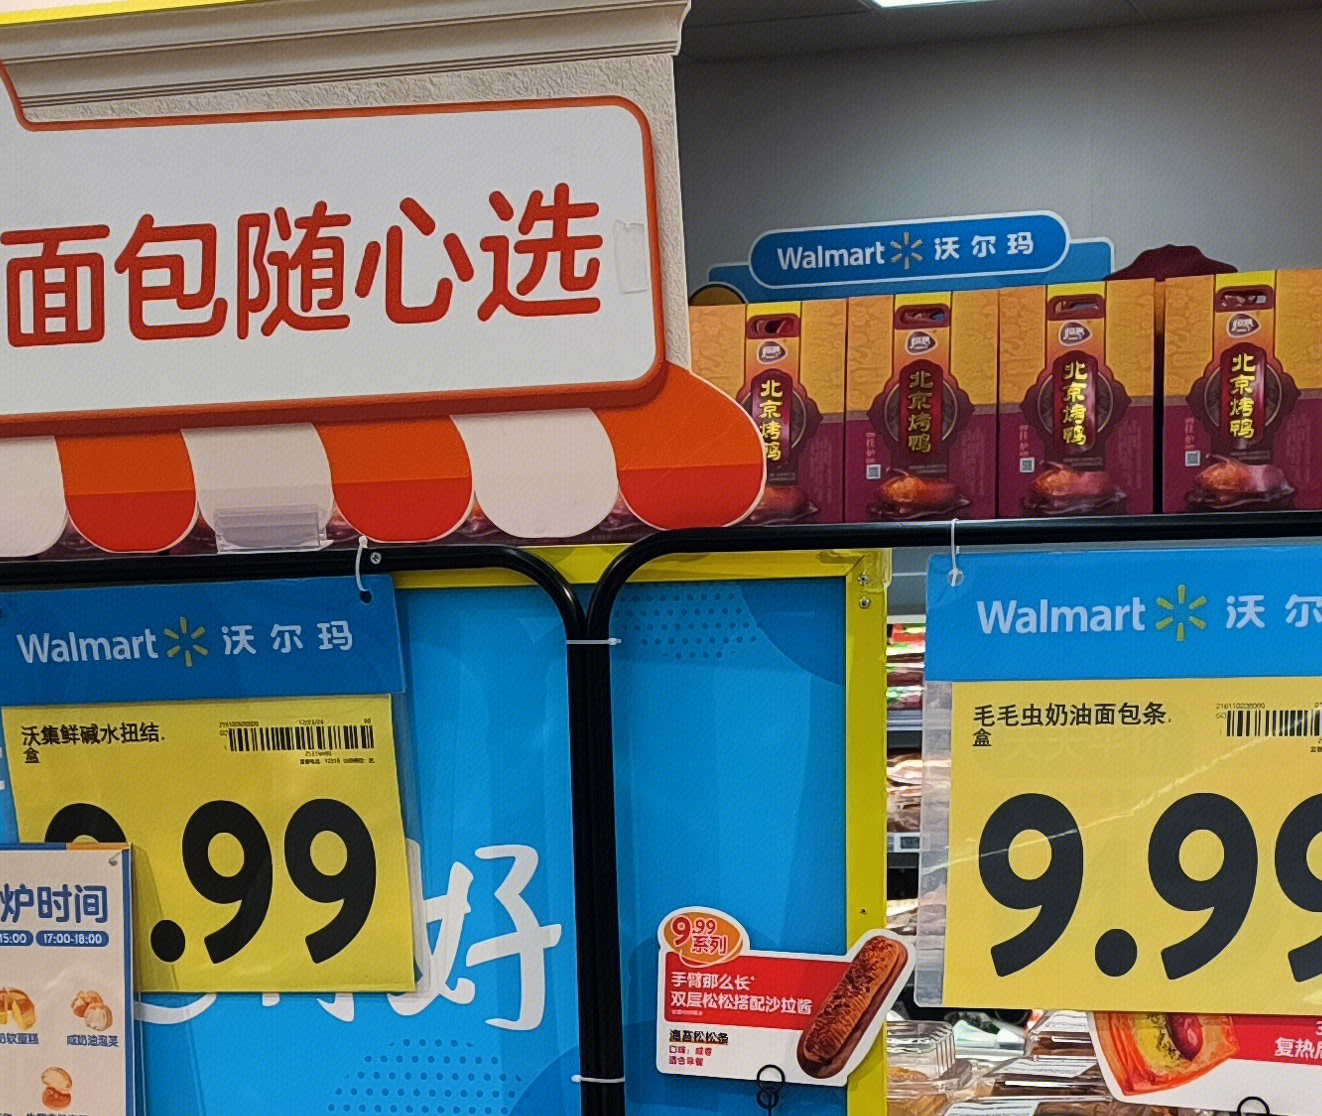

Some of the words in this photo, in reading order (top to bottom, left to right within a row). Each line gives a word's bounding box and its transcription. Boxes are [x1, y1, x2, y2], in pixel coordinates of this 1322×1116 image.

[0, 182, 605, 348] 面包随心选
[776, 239, 885, 270] Walmart
[934, 231, 1035, 260] 沃尔玛
[907, 371, 934, 453] 北京烤鸭
[1062, 361, 1088, 446] 北京烤鸭
[1229, 353, 1256, 439] 北京烤鸭
[976, 597, 1146, 634] Walmart
[16, 628, 159, 665] Walmart
[221, 620, 353, 657] 沃尔玛
[24, 747, 41, 765] 盒
[972, 728, 993, 749] 盒
[44, 933, 103, 945] 17:00-18:00
[671, 916, 716, 945] 9.99
[693, 936, 727, 954] 系列
[670, 991, 813, 1015] 双层松松搭配沙拉酱
